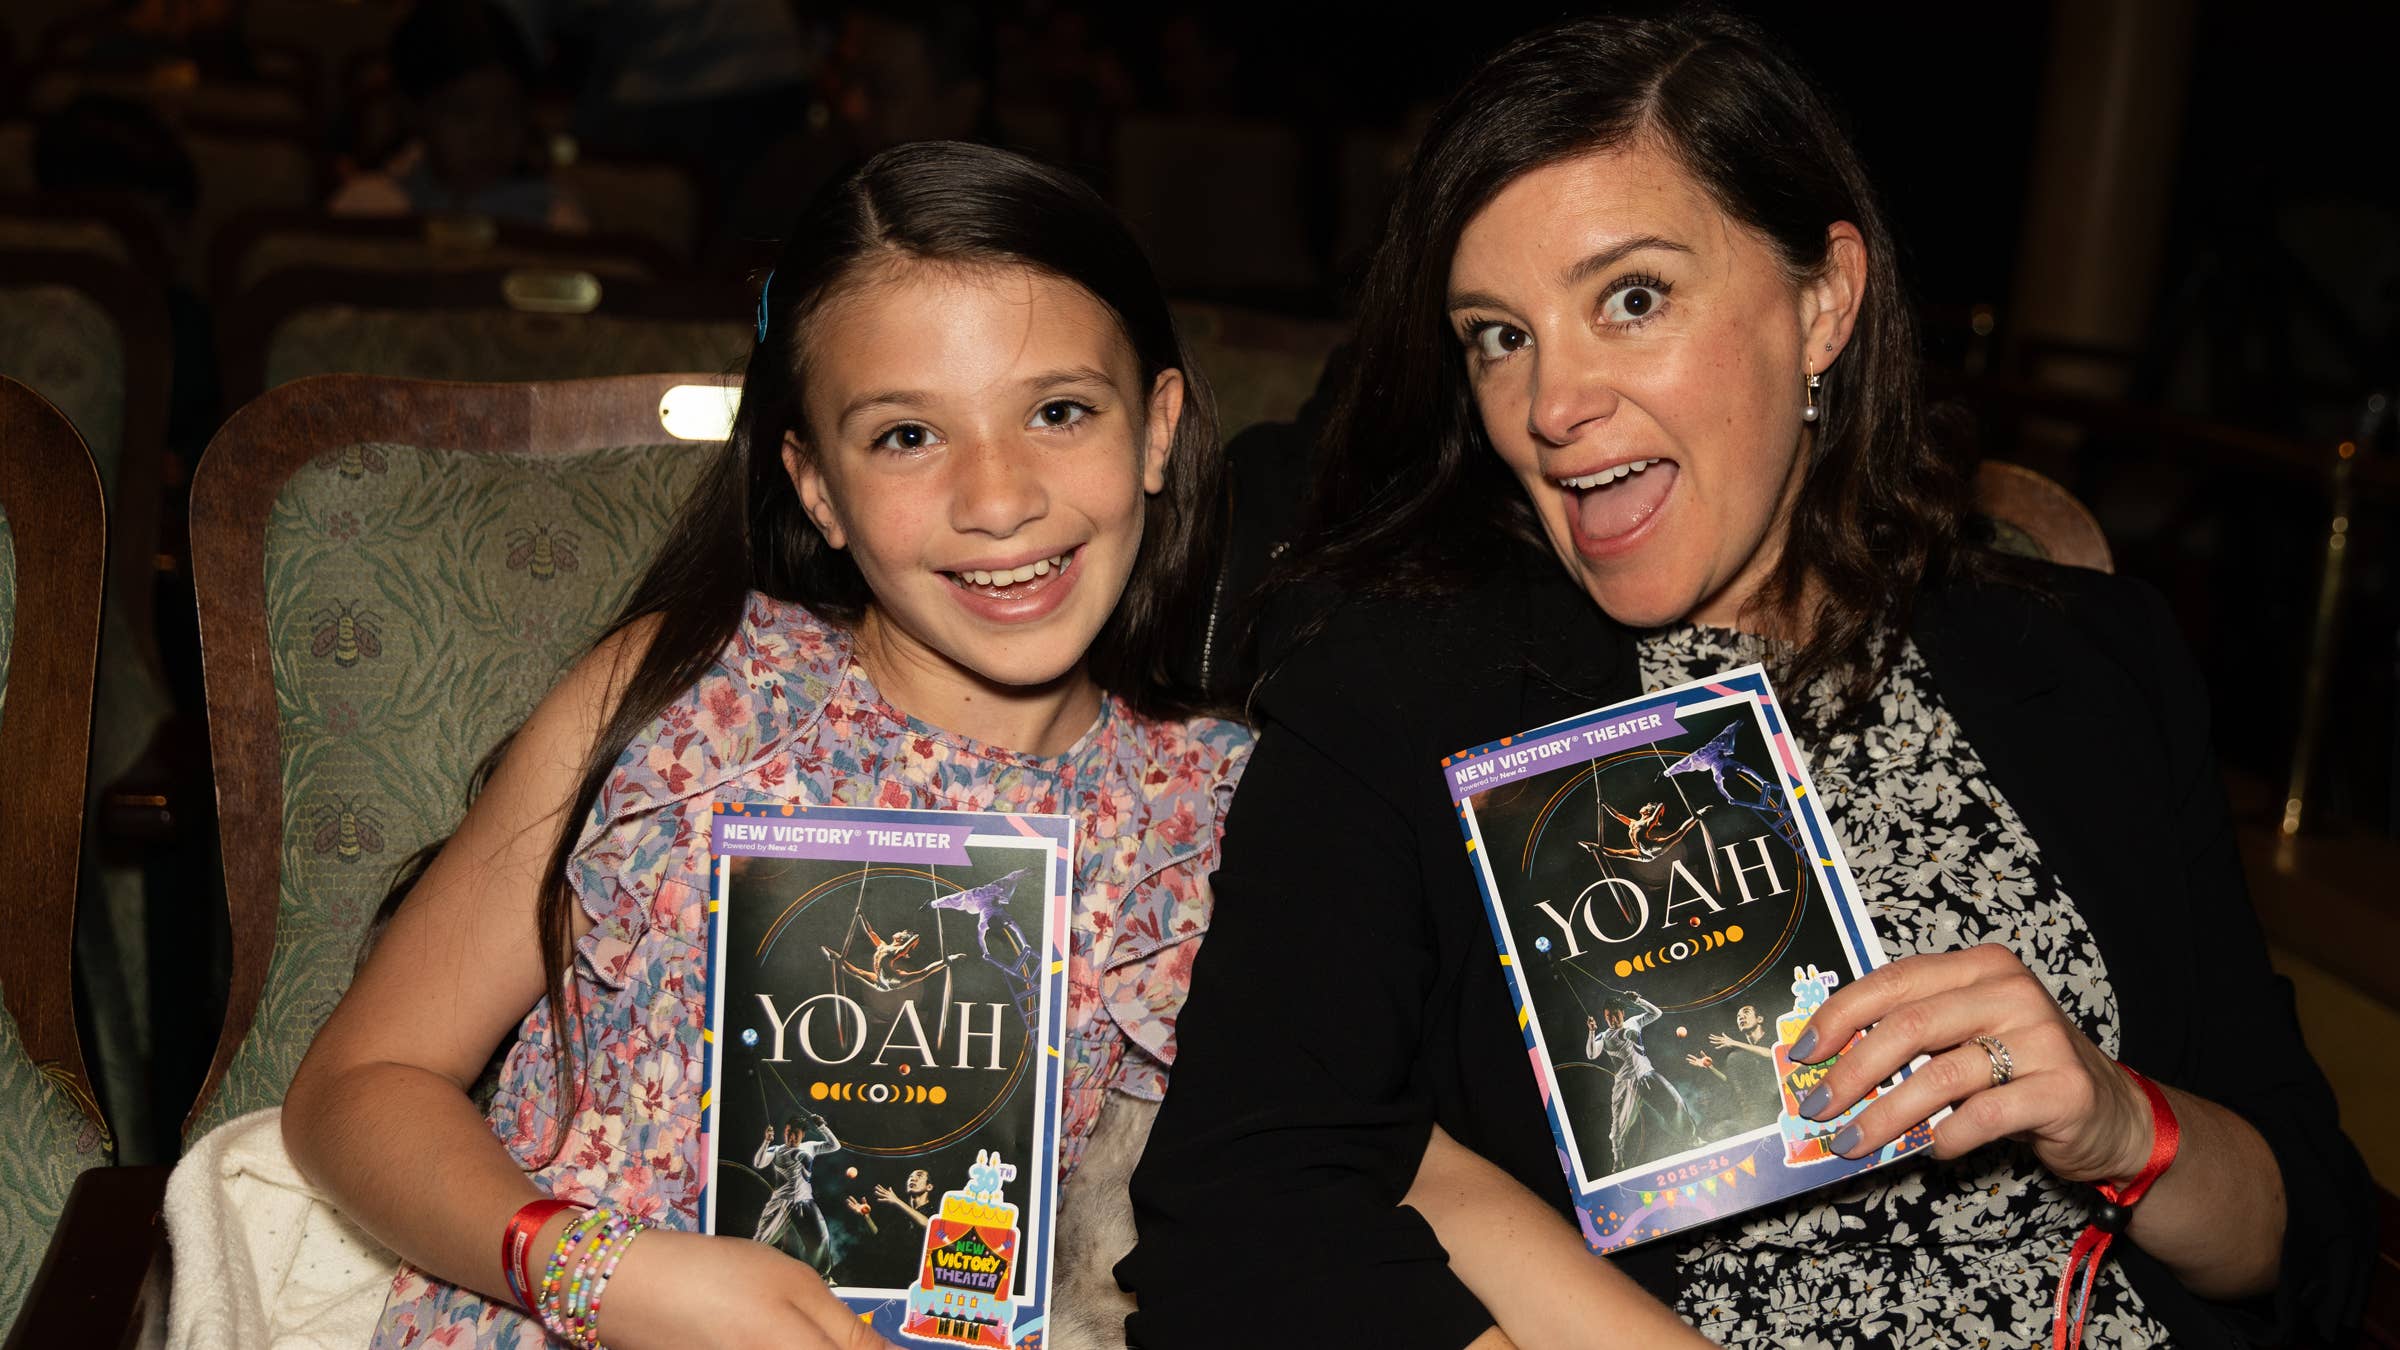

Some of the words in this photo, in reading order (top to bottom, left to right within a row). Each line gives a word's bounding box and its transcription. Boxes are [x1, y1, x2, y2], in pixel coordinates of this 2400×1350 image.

[1455, 759, 1495, 784] NEW
[1583, 713, 1662, 745] THEATER
[1459, 778, 1489, 793] Powered
[1490, 774, 1499, 785] by
[1499, 768, 1516, 779] New
[1517, 766, 1528, 774] 42
[722, 841, 755, 850] Powered
[757, 842, 767, 852] by
[768, 843, 786, 851] New
[787, 844, 798, 852] 42
[723, 823, 768, 840] NEW
[866, 830, 951, 849] THEATER
[1534, 835, 1790, 961] YOAH
[755, 993, 1010, 1070] YOAH
[1792, 1068, 1829, 1090] VICT
[1657, 1155, 1730, 1187] 2025-26
[937, 1249, 1000, 1273] VICTORY
[955, 1240, 986, 1256] NEW
[935, 1267, 998, 1289] THEATER
